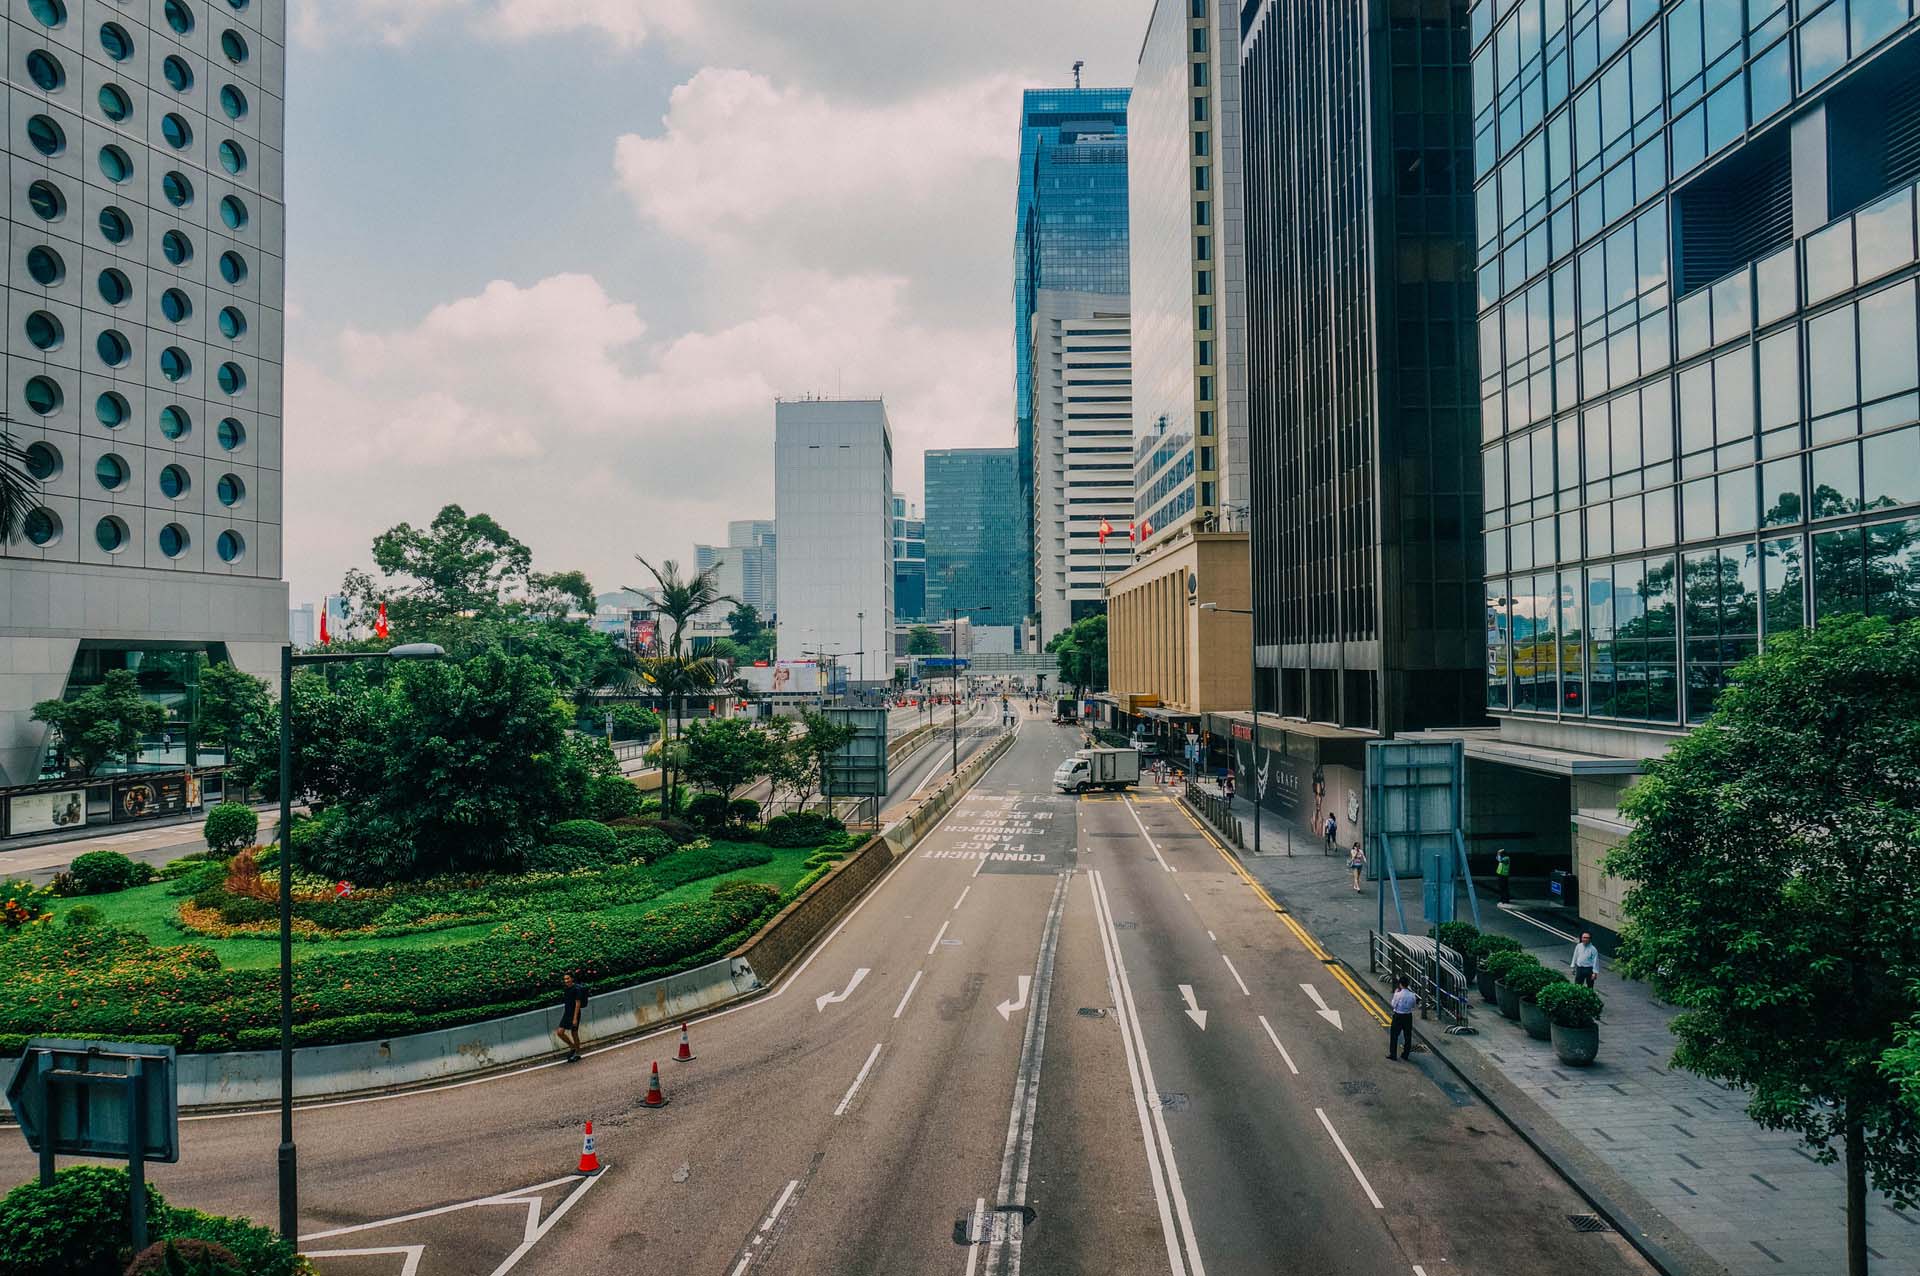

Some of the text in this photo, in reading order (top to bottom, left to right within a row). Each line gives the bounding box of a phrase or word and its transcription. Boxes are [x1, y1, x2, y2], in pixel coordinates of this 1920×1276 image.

[1276, 770, 1299, 790] GRAFF
[943, 825, 1045, 835] EDINBURGH
[952, 841, 1025, 851] PLACE
[920, 850, 1046, 861] CONNAUGHT
